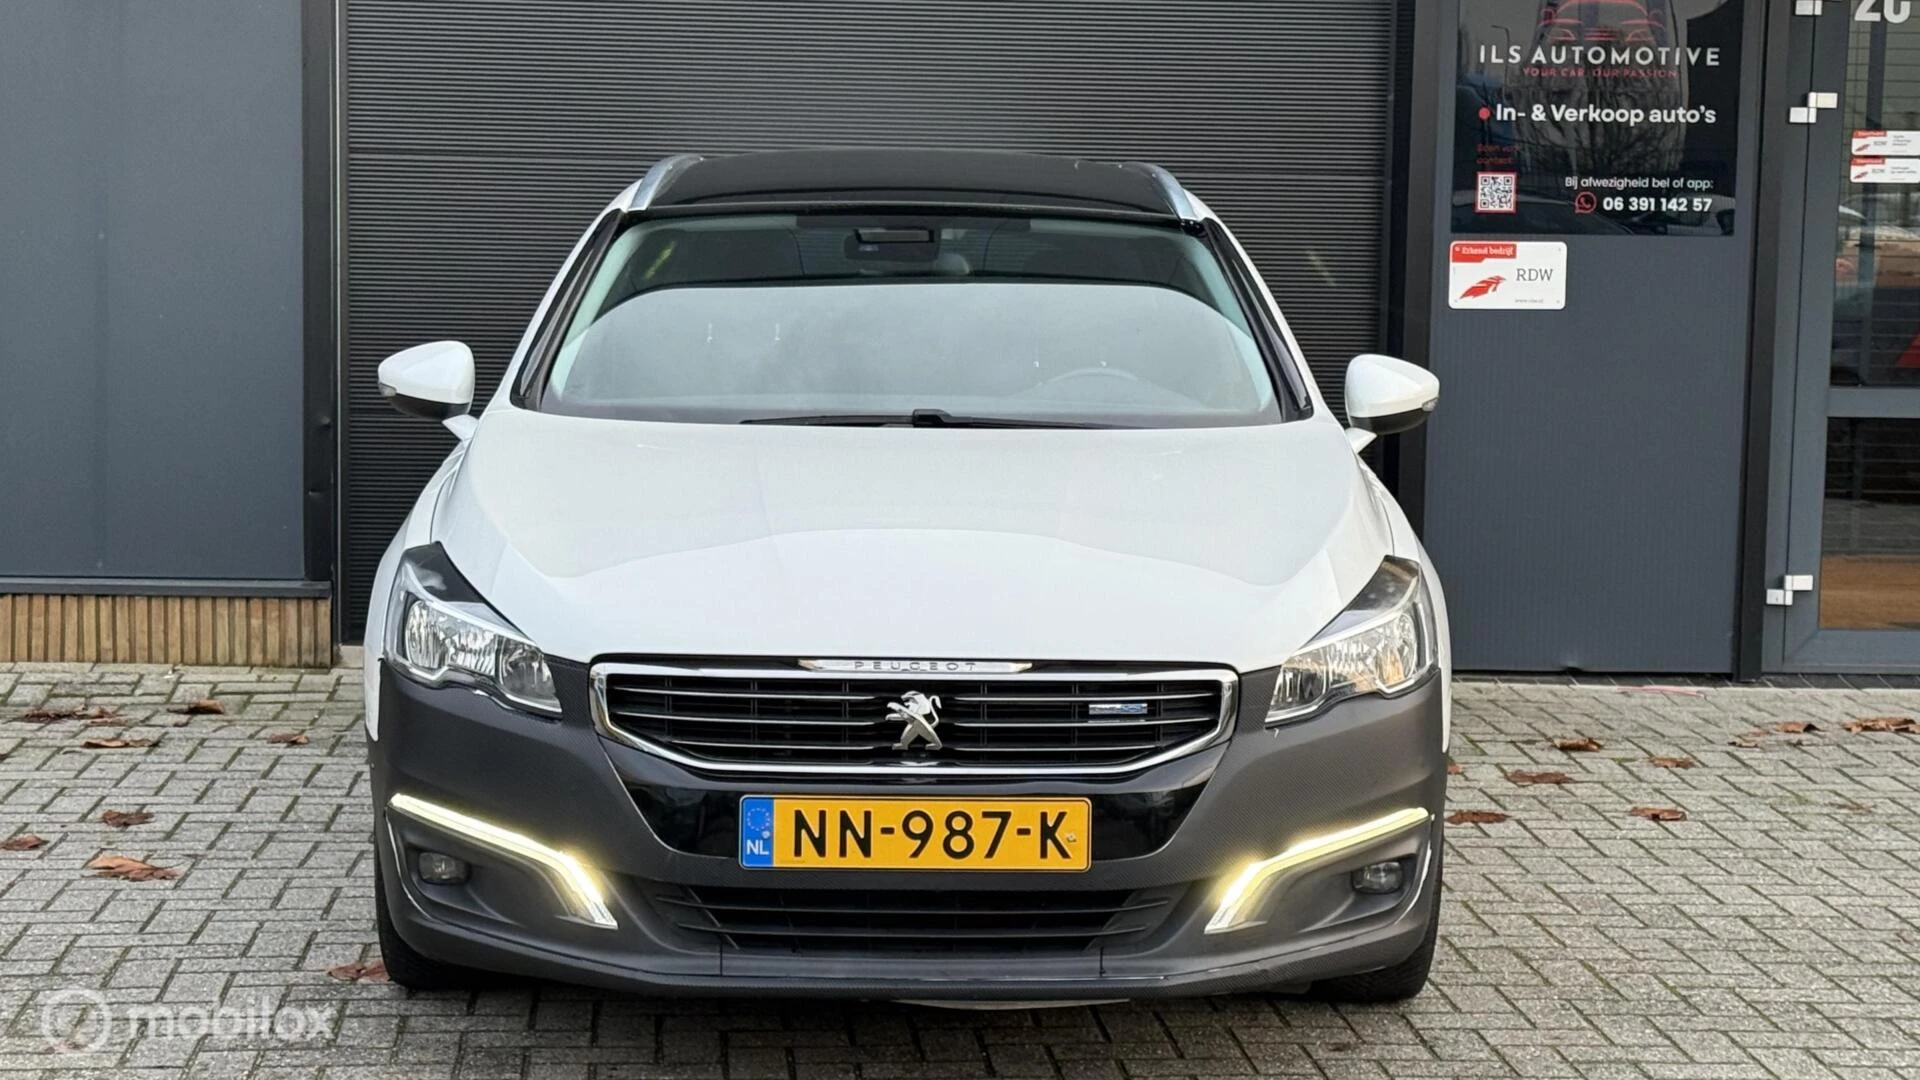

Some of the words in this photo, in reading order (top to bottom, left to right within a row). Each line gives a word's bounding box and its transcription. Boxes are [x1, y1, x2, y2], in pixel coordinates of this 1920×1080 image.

[1479, 45, 1521, 64] ILS
[1531, 46, 1720, 66] AUTOMOTIVE
[1523, 67, 1559, 78] YOUR
[1592, 68, 1622, 78] OUR
[1624, 68, 1679, 79] PASSION
[1496, 104, 1526, 121] In-
[1531, 104, 1546, 121] &
[1550, 104, 1644, 126] Verkoop
[1565, 176, 1578, 190] Bij
[1580, 177, 1649, 191] afwezigheid
[1652, 177, 1670, 188] bel
[1672, 177, 1686, 189] of
[1687, 180, 1714, 191] app:
[1603, 197, 1624, 211] 06
[1628, 197, 1656, 211] 391
[1661, 197, 1687, 211] 142
[1692, 198, 1713, 212] 57
[1516, 268, 1554, 281] RDW
[854, 661, 976, 671] PEUGEOT
[794, 809, 1072, 860] NN-987-K
[746, 840, 769, 855] NL
